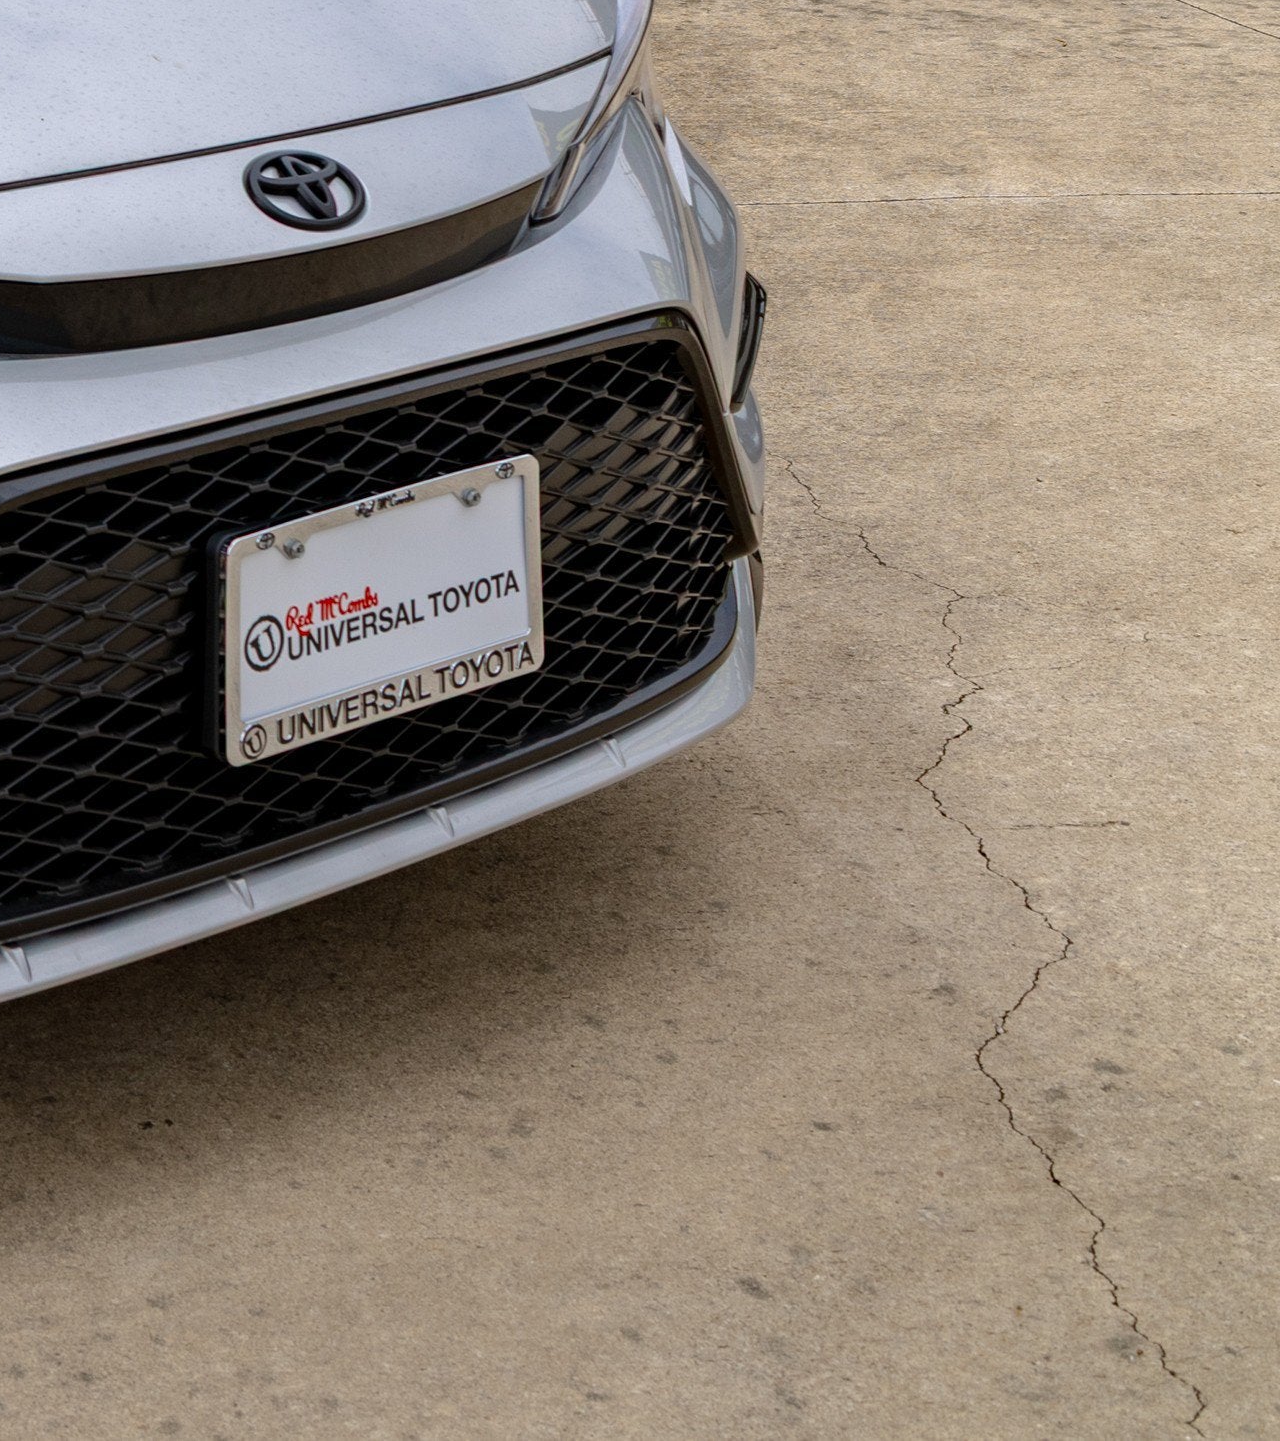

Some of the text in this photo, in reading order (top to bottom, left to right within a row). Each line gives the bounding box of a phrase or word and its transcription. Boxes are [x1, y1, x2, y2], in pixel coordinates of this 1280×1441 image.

[288, 570, 520, 661] UNIVERSAL TOYOTA
[277, 641, 535, 745] UNIVERSAL TOYOTA
